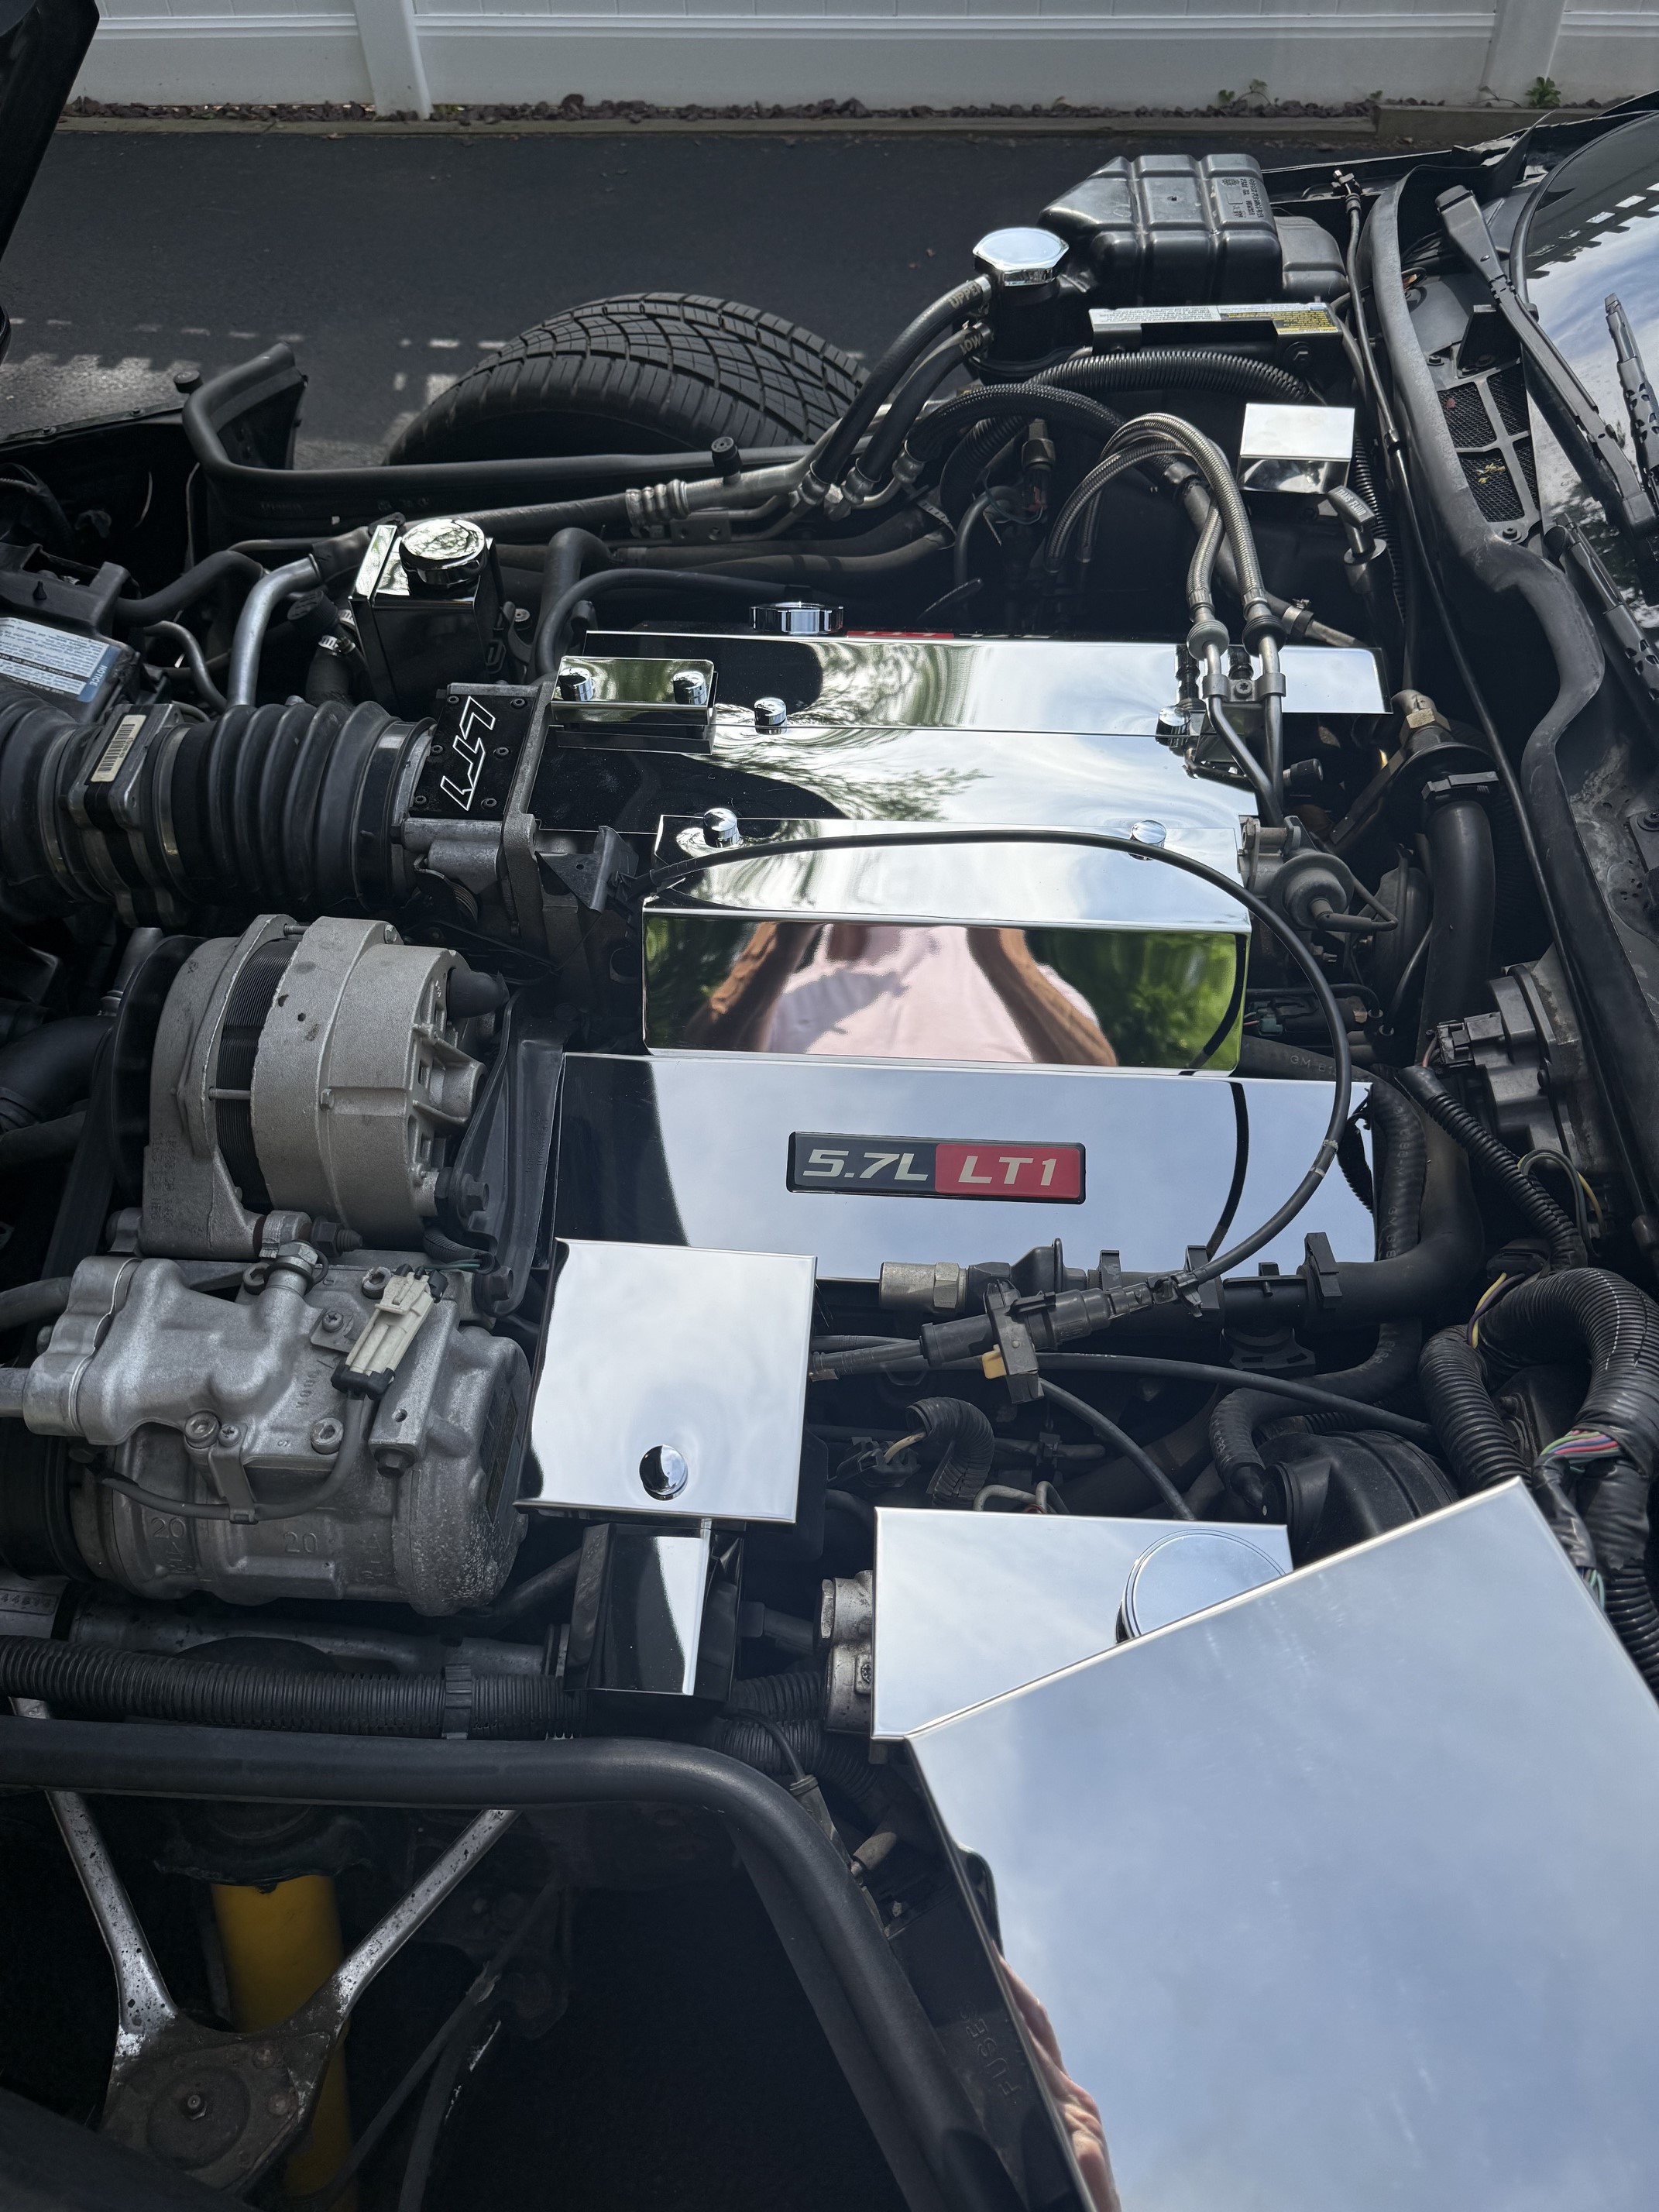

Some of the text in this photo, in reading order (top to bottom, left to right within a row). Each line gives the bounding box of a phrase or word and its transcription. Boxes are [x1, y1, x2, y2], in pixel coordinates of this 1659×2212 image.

[1348, 500, 1367, 517] FLUID
[89, 665, 108, 686] NOTICE
[441, 696, 496, 812] LT1
[802, 1149, 1058, 1187] 5.7L LT1
[150, 1516, 187, 1539] 20
[283, 1530, 319, 1554] 20
[958, 2000, 1021, 2097] FUSES
